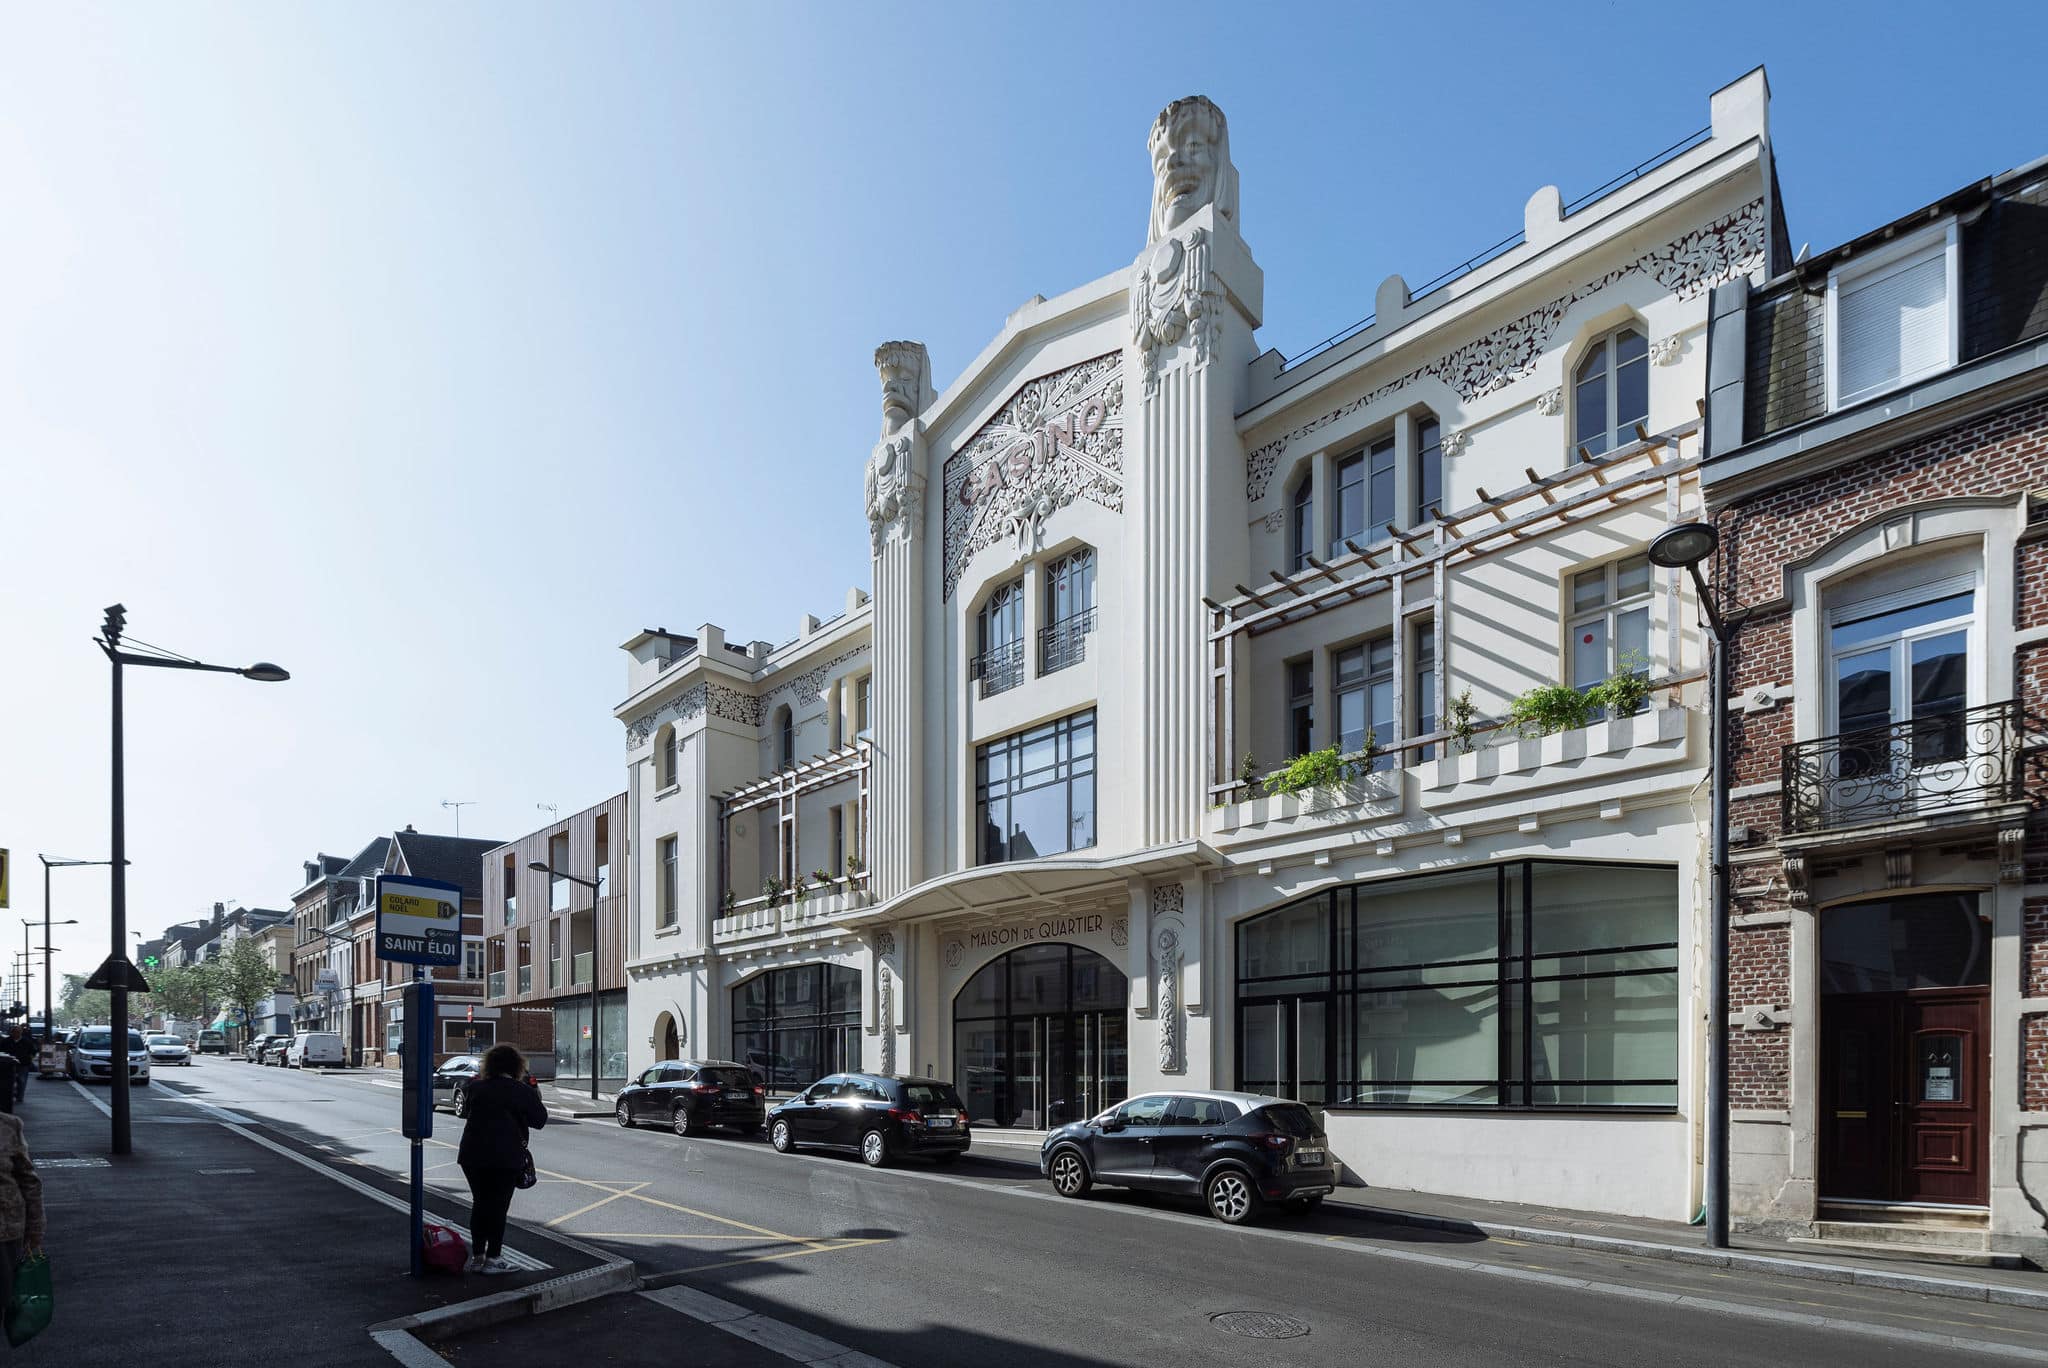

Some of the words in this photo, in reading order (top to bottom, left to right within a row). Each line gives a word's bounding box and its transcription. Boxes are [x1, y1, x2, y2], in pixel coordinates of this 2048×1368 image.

[959, 399, 1106, 506] CASINO
[389, 896, 420, 907] COLARD
[970, 927, 1019, 948] MAISON
[1023, 927, 1035, 940] DE
[1038, 914, 1103, 938] QUARTIER
[385, 937, 424, 953] SAINT
[428, 939, 455, 956] ÉLOI
